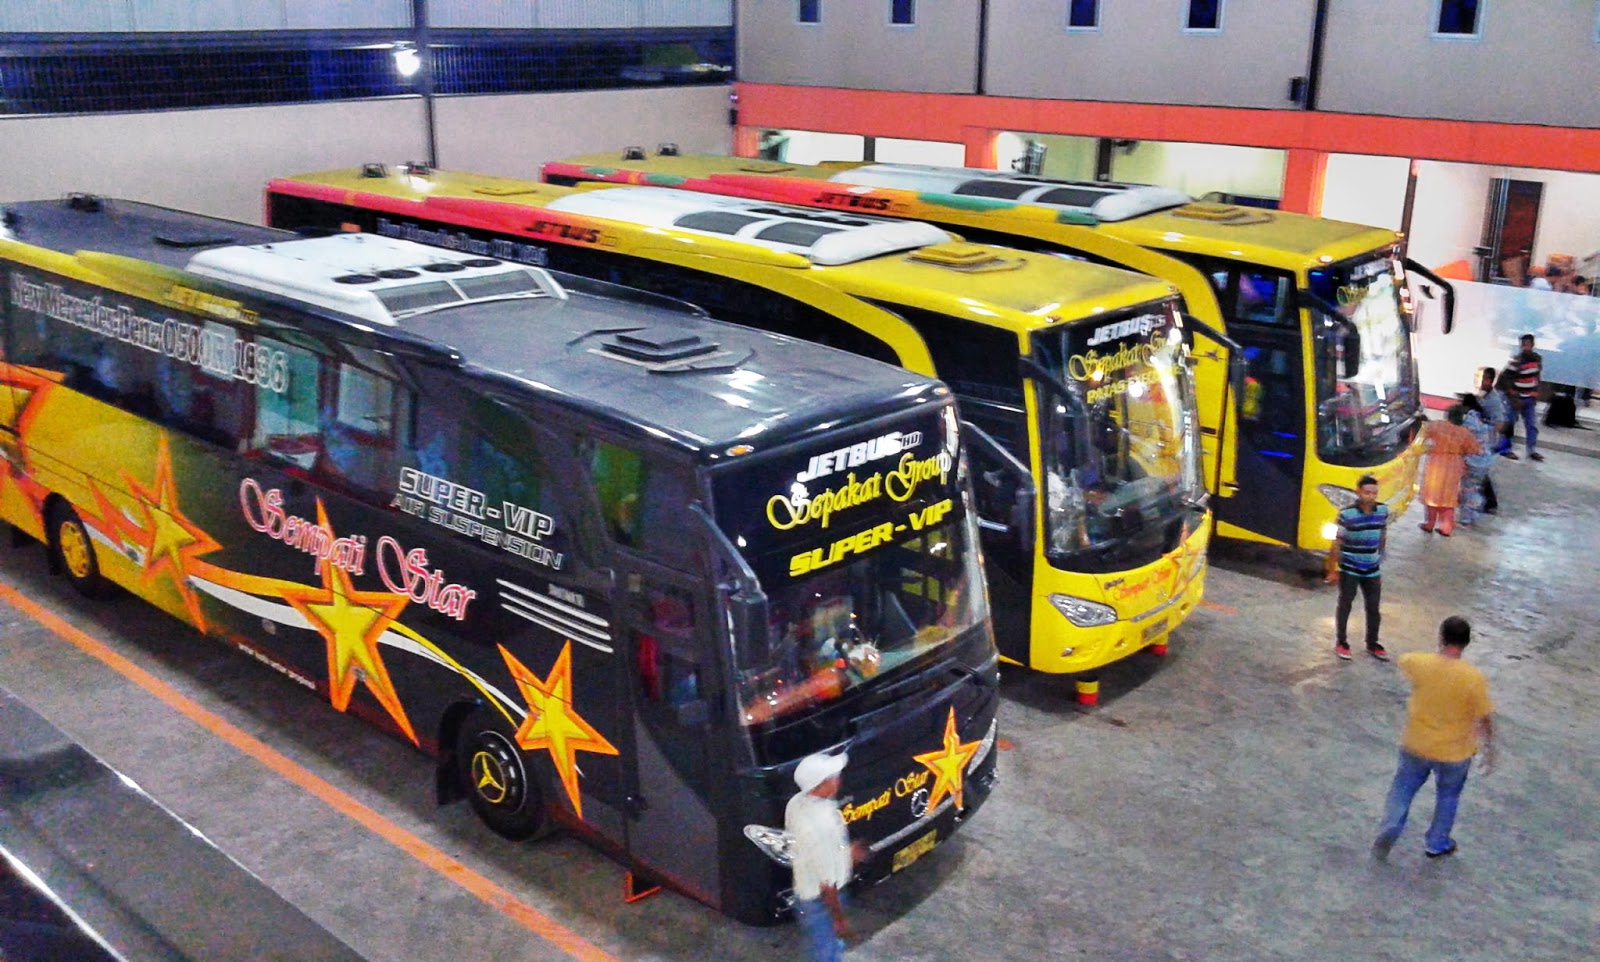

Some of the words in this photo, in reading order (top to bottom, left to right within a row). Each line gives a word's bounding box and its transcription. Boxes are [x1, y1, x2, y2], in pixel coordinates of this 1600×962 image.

[766, 472, 883, 530] Sepakat
[885, 452, 952, 502] Group
[797, 431, 903, 483] JETBUS
[240, 477, 368, 576] Sempati
[376, 534, 477, 621] Star
[391, 493, 425, 521] AIR
[428, 504, 564, 571] SUSPENSION
